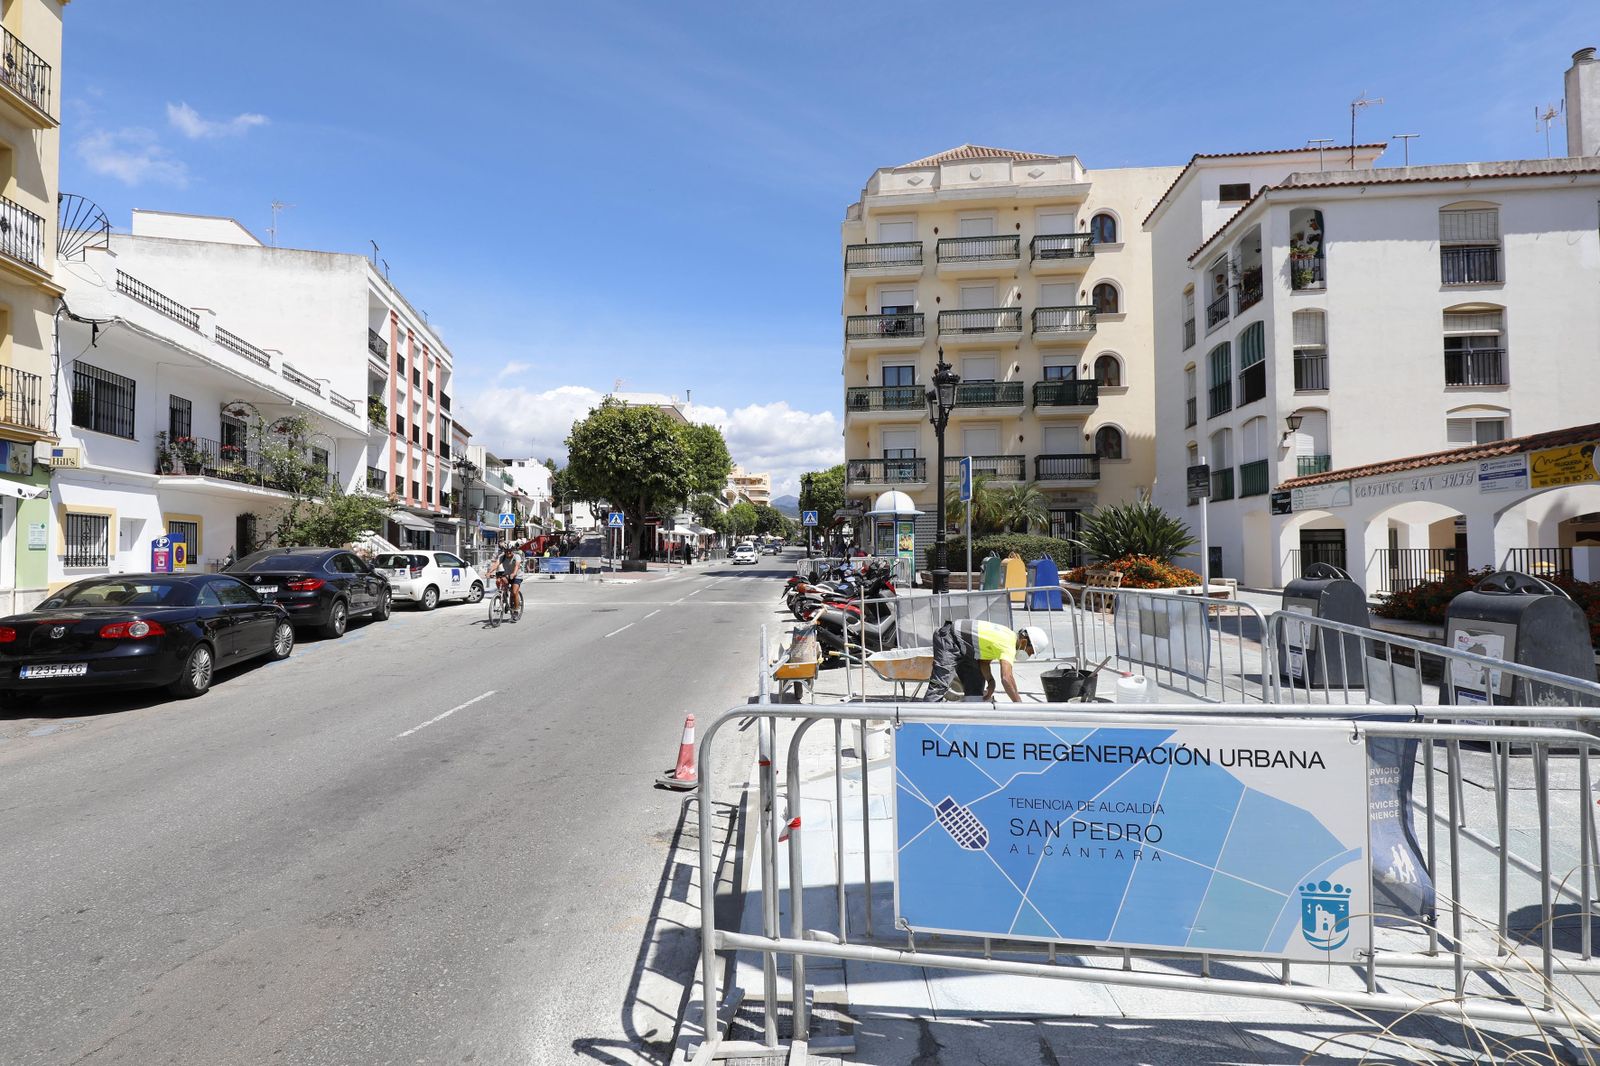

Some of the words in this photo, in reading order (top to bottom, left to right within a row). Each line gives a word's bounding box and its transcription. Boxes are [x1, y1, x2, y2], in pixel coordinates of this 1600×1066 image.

[52, 457, 75, 466] Hill's
[30, 665, 58, 676] 1235
[921, 739, 979, 759] PLAN
[986, 741, 1016, 760] DE
[1023, 742, 1211, 767] REGENERACIÓN
[1219, 748, 1326, 770] URBANA
[1008, 797, 1074, 812] TENENCIA
[1077, 800, 1095, 812] DE
[1099, 801, 1165, 815] ALCALDÍA
[1009, 817, 1060, 838] SAN
[1072, 821, 1163, 843] PEDRO
[1009, 843, 1162, 862] ALCÁNTARA
